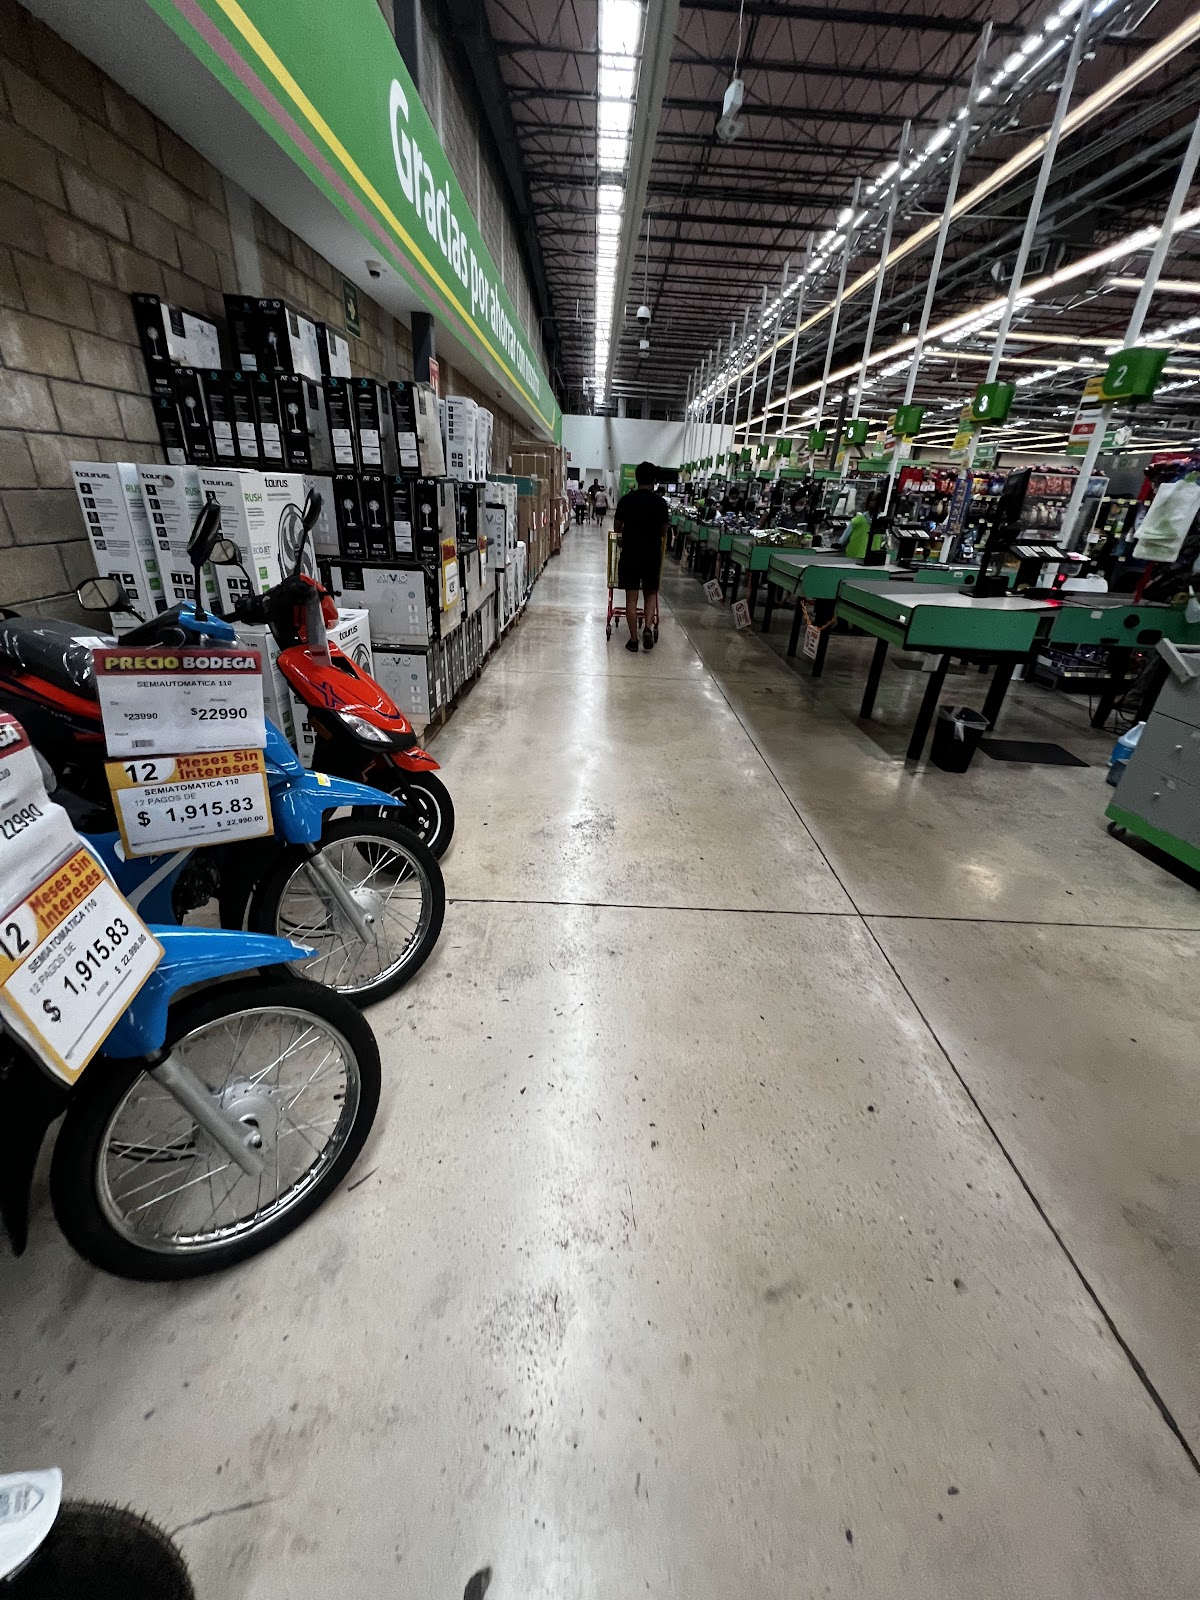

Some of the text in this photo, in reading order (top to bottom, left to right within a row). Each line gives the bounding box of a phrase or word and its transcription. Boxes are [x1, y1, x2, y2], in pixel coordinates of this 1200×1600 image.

[389, 78, 468, 289] Gracias
[470, 247, 489, 321] por
[490, 283, 517, 365] ahorrar
[258, 300, 280, 308] ATIO
[1112, 365, 1128, 387] 2
[979, 395, 988, 412] 3
[75, 471, 111, 479] taurus
[264, 477, 288, 488] taurus
[125, 484, 141, 493] RUS
[202, 479, 234, 487] taurus
[244, 493, 263, 502] RUSH
[339, 625, 358, 640] taurus
[105, 656, 256, 670] PRECIO BODEGA
[137, 680, 216, 688] SEMIAUTOMATICA
[124, 712, 158, 721] $23990
[191, 707, 248, 721] $22990
[176, 751, 258, 769] Meses Sin
[125, 762, 158, 783] 12
[179, 762, 259, 780] Intereses
[144, 778, 239, 796] SEMIATOMATICA 110
[147, 794, 182, 806] PAGOS
[183, 792, 197, 800] DE
[137, 797, 254, 827] $ 1,915.83
[29, 874, 72, 916] Meses
[69, 856, 92, 878] Sin
[40, 869, 101, 930] Intereses
[28, 911, 86, 974] SEMIATOMATICA
[84, 898, 98, 914] 110
[63, 942, 77, 957] DE
[42, 998, 62, 1022] $
[64, 918, 129, 996] 1,915.83
